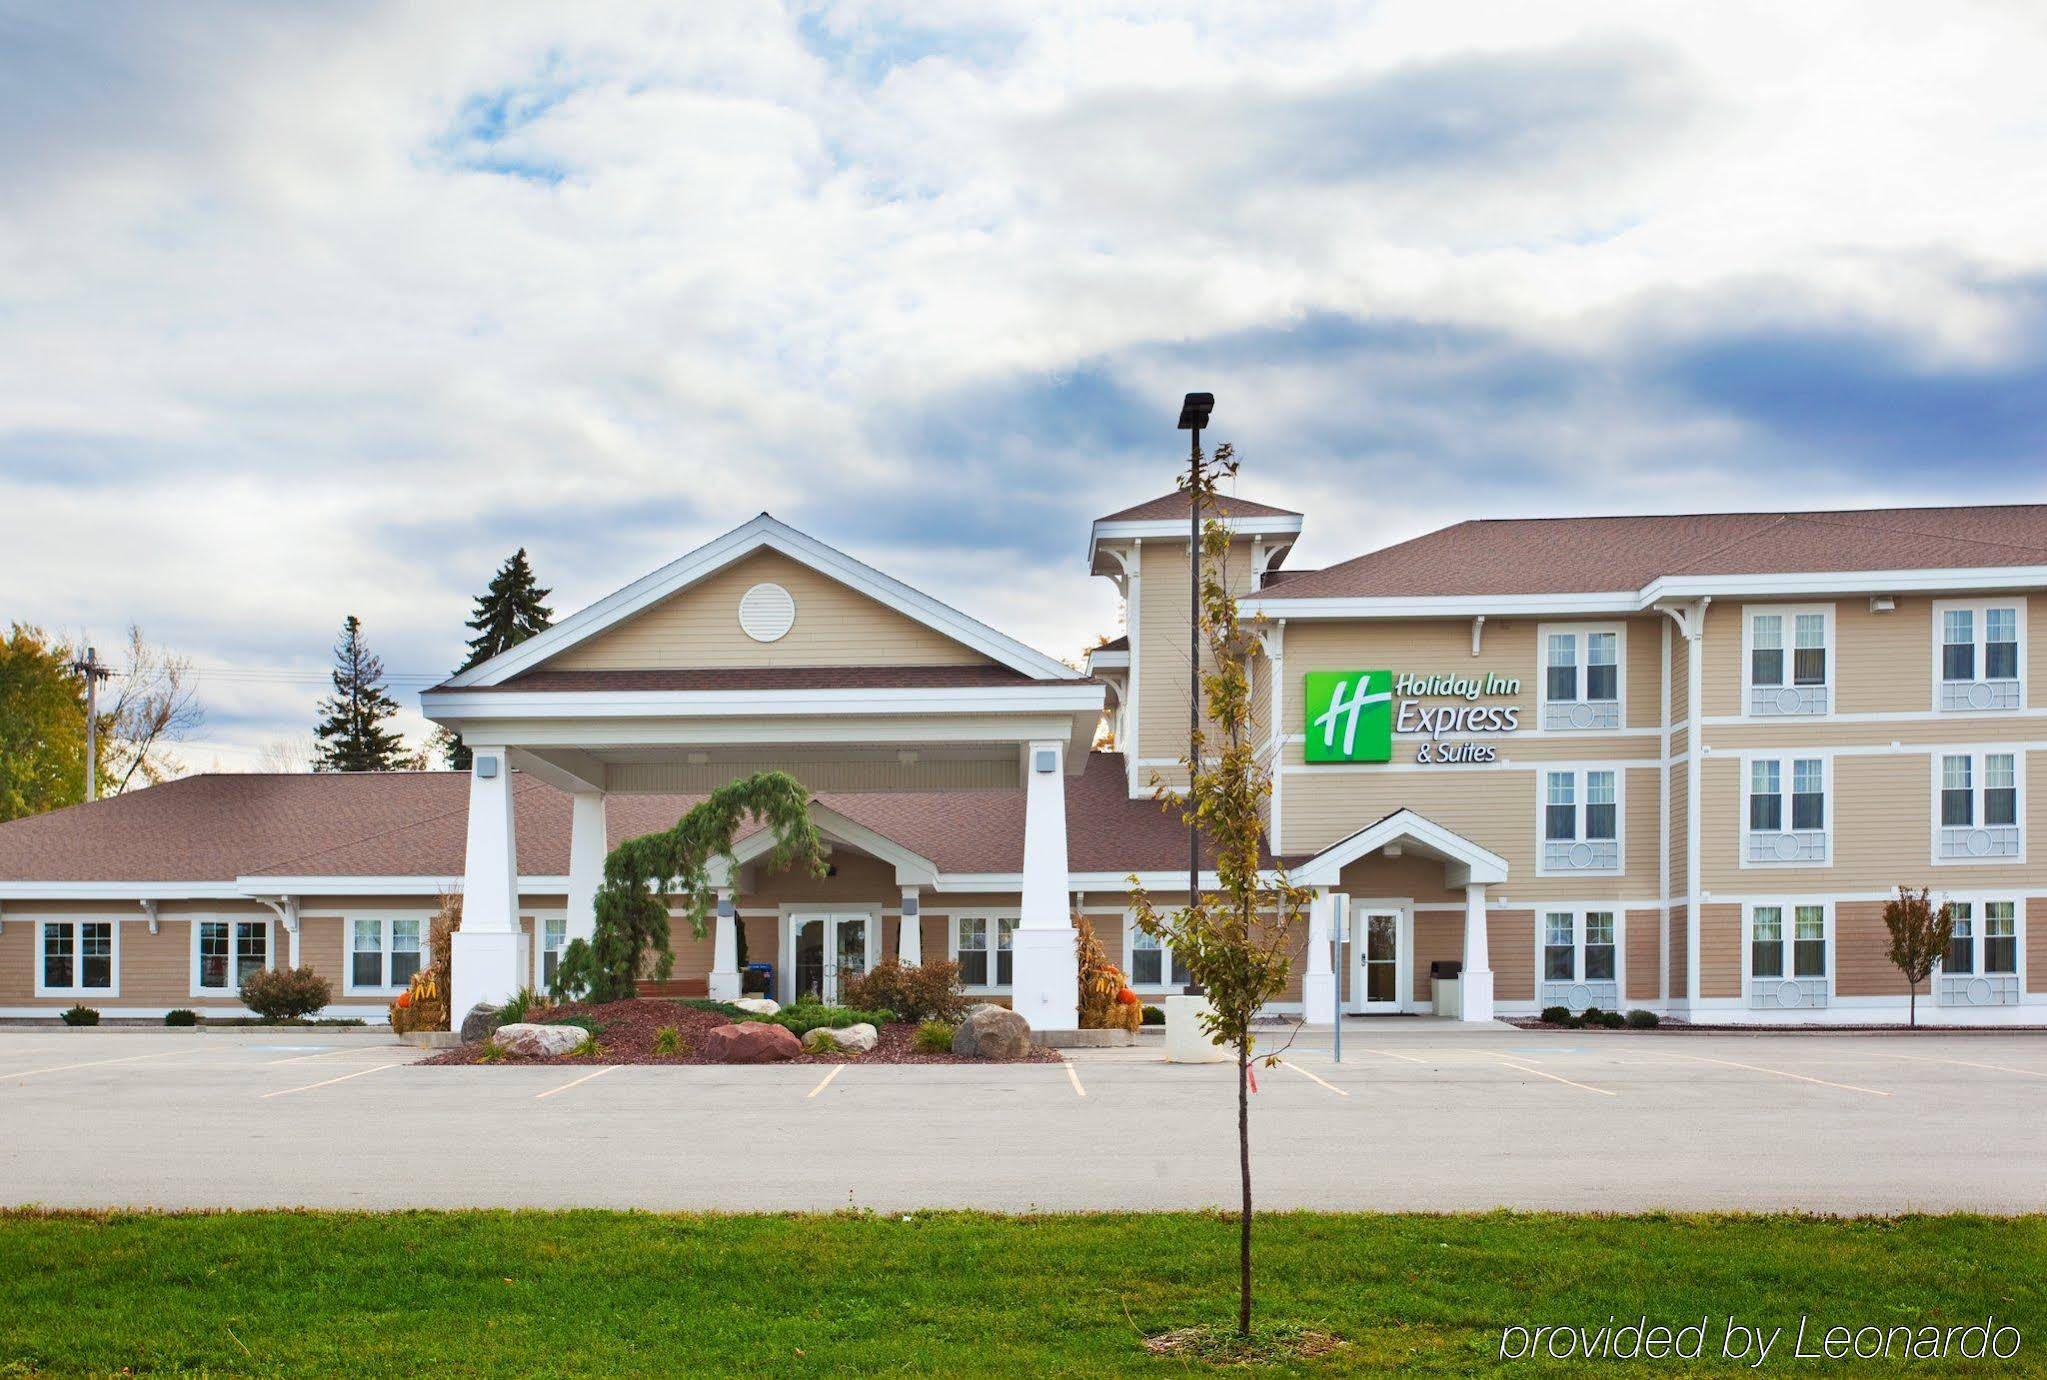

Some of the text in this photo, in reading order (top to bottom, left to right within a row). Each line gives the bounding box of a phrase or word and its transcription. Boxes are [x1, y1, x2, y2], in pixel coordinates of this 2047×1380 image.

[1395, 672, 1520, 700] Holiday Inn
[1314, 675, 1391, 755] H
[1396, 700, 1519, 740] Express
[1417, 743, 1496, 763] & Suites
